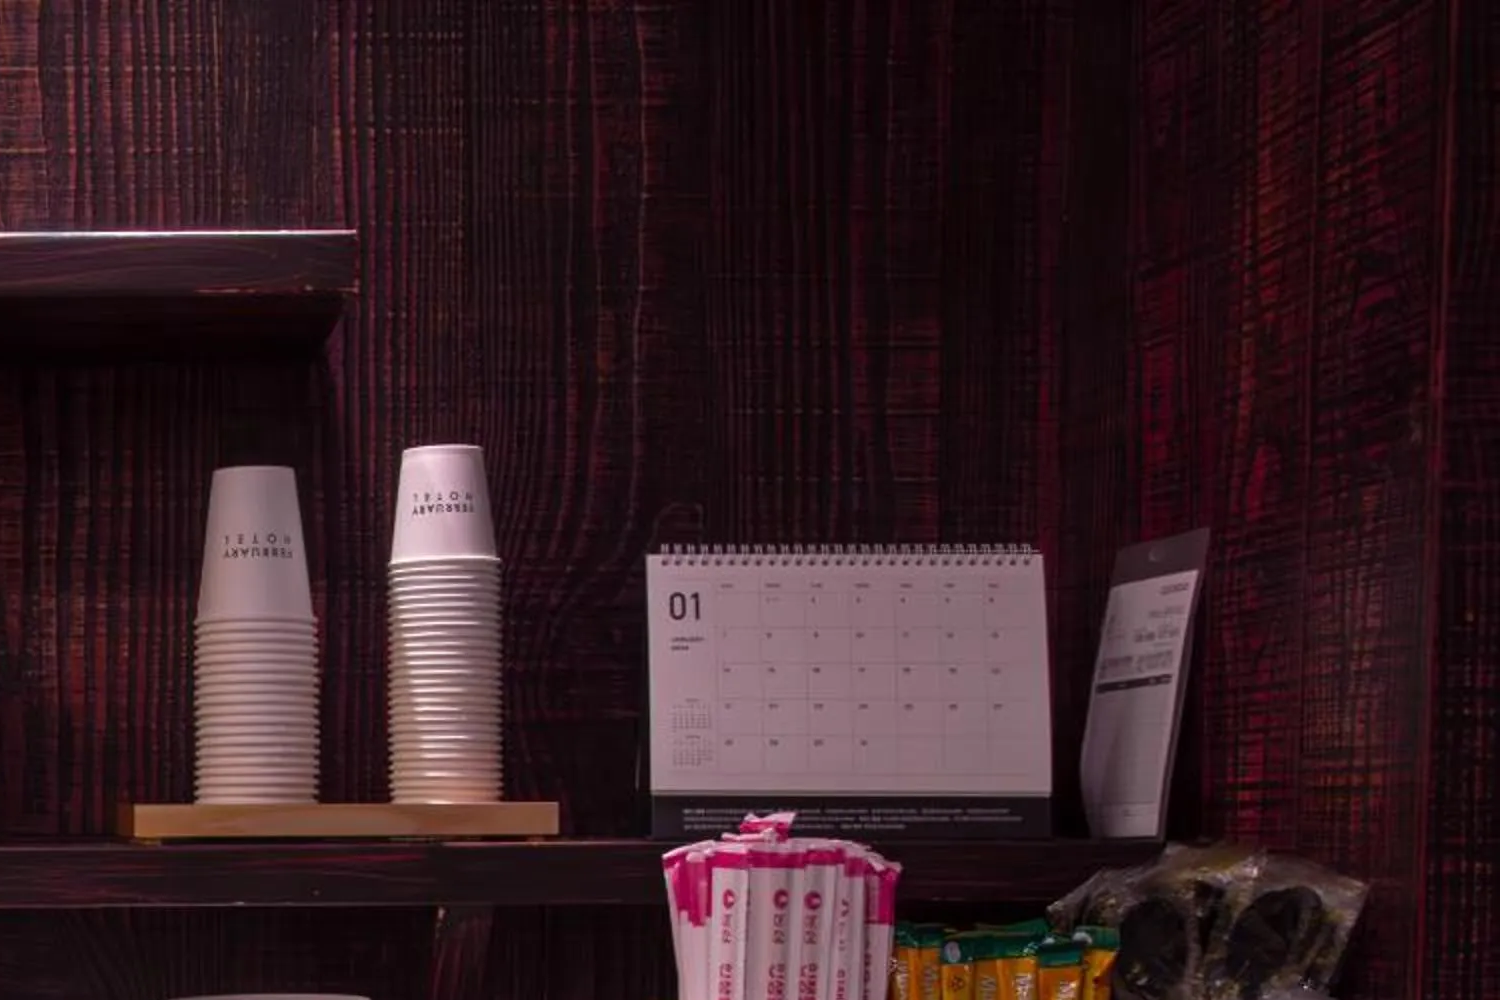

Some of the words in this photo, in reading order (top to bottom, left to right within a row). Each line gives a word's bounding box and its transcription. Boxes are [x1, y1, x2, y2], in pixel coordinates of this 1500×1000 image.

[412, 503, 475, 516] FEBRUARY
[223, 546, 294, 560] FEBRUARY
[669, 592, 701, 621] 01
